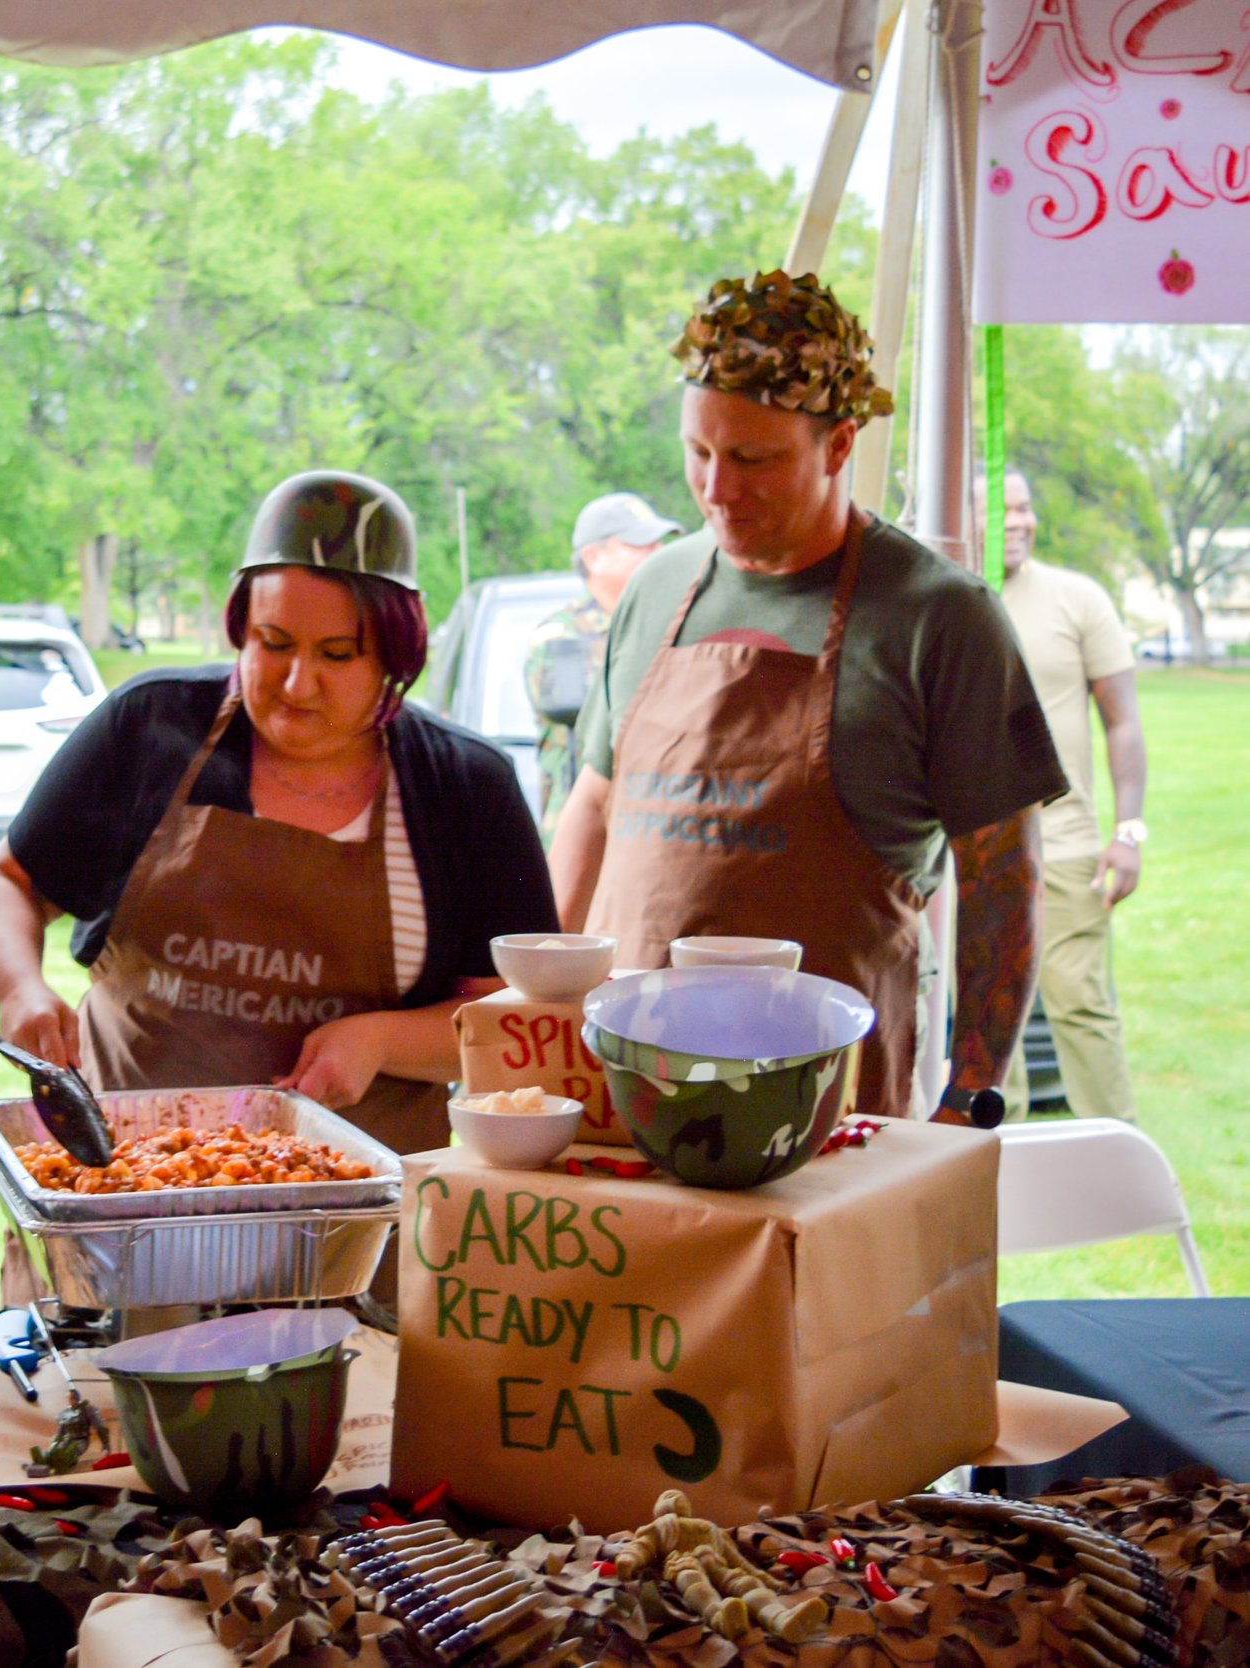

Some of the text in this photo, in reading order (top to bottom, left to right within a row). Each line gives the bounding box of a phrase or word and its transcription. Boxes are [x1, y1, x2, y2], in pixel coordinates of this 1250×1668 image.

[147, 967, 345, 1024] AMERICANO
[162, 932, 324, 987] CAPTIAN
[414, 1175, 627, 1278] CARBS
[435, 1275, 683, 1374] READY TO
[497, 1376, 634, 1457] EAT
